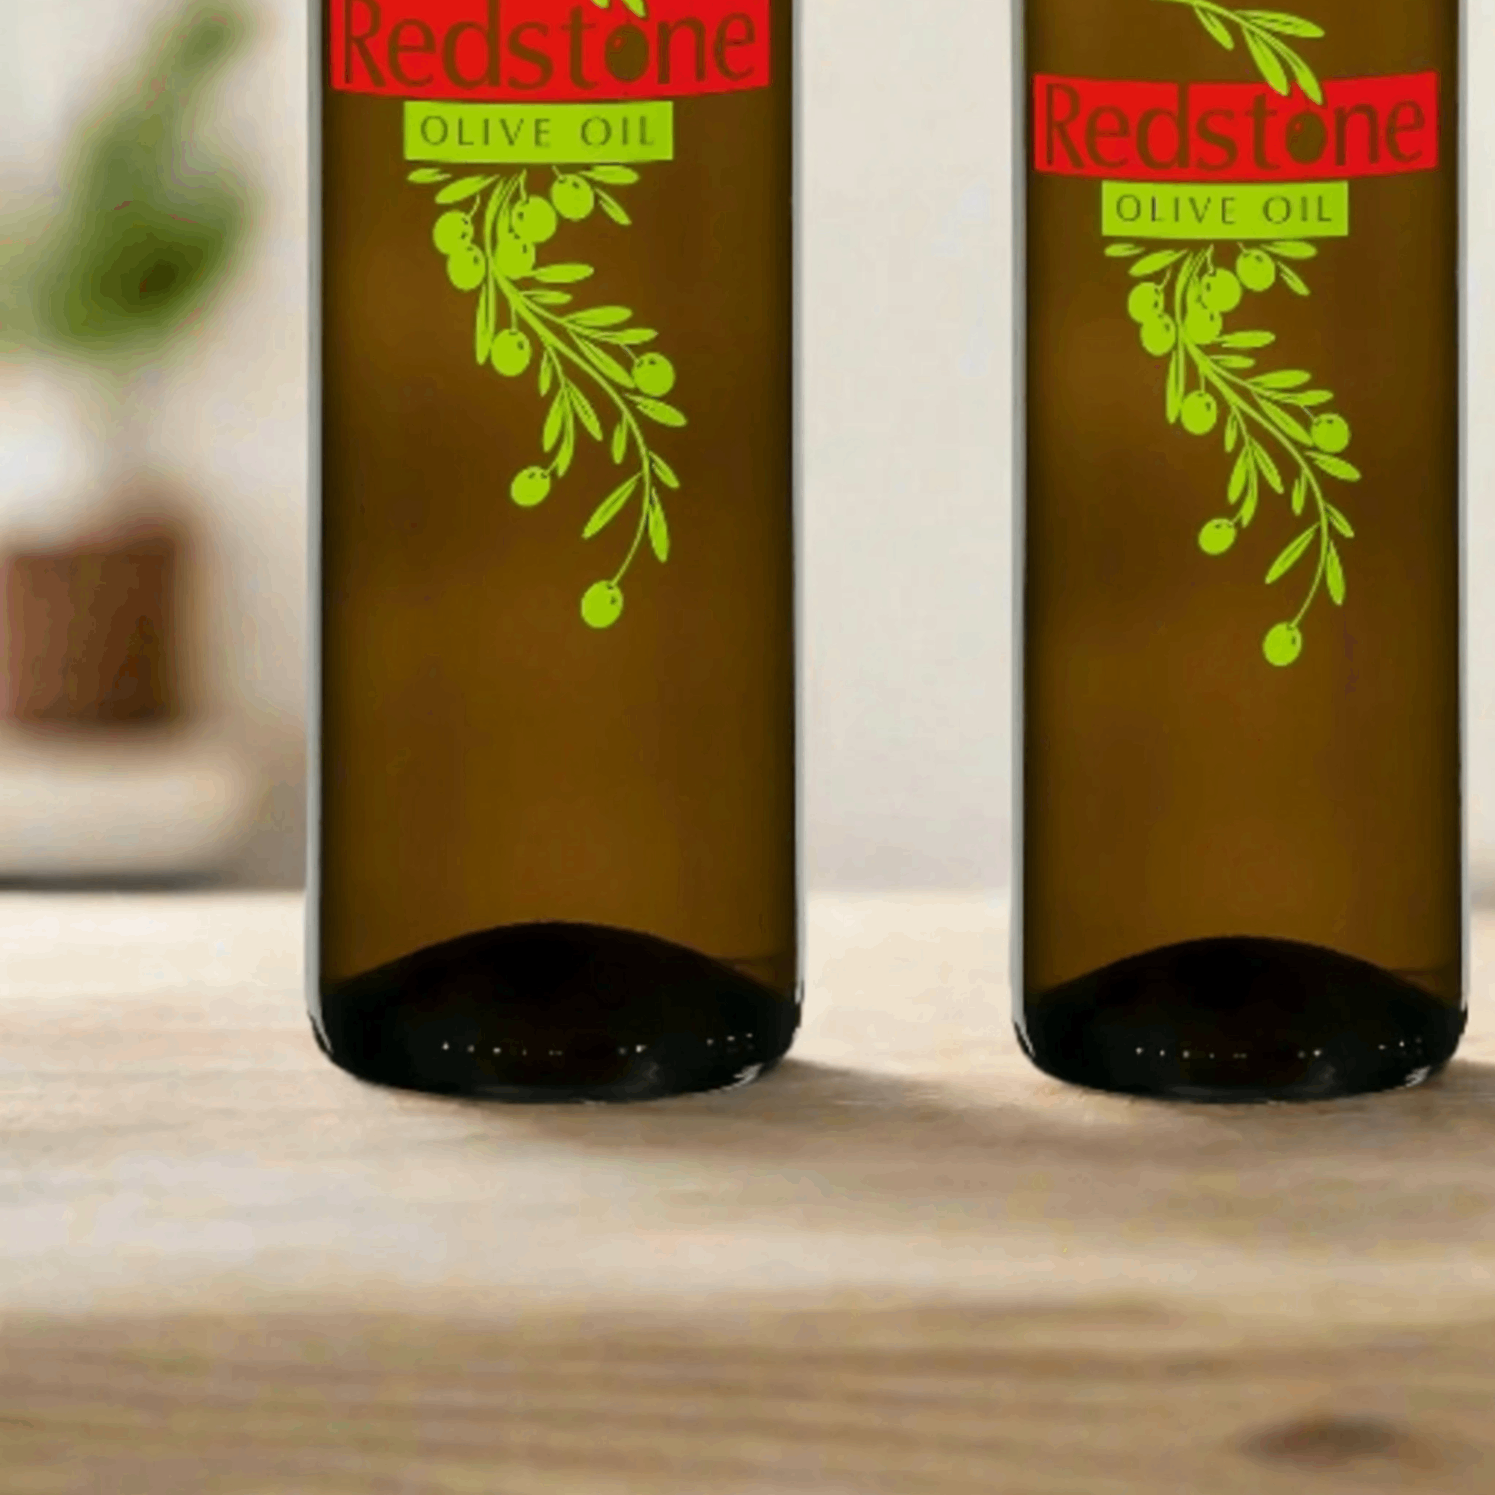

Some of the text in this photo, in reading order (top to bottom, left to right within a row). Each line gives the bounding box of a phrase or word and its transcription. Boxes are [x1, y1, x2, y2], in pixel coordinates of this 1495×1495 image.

[420, 115, 654, 148] OLIVE OIL
[1046, 81, 1426, 172] Redstone
[1116, 194, 1332, 225] OLIVE OIL
